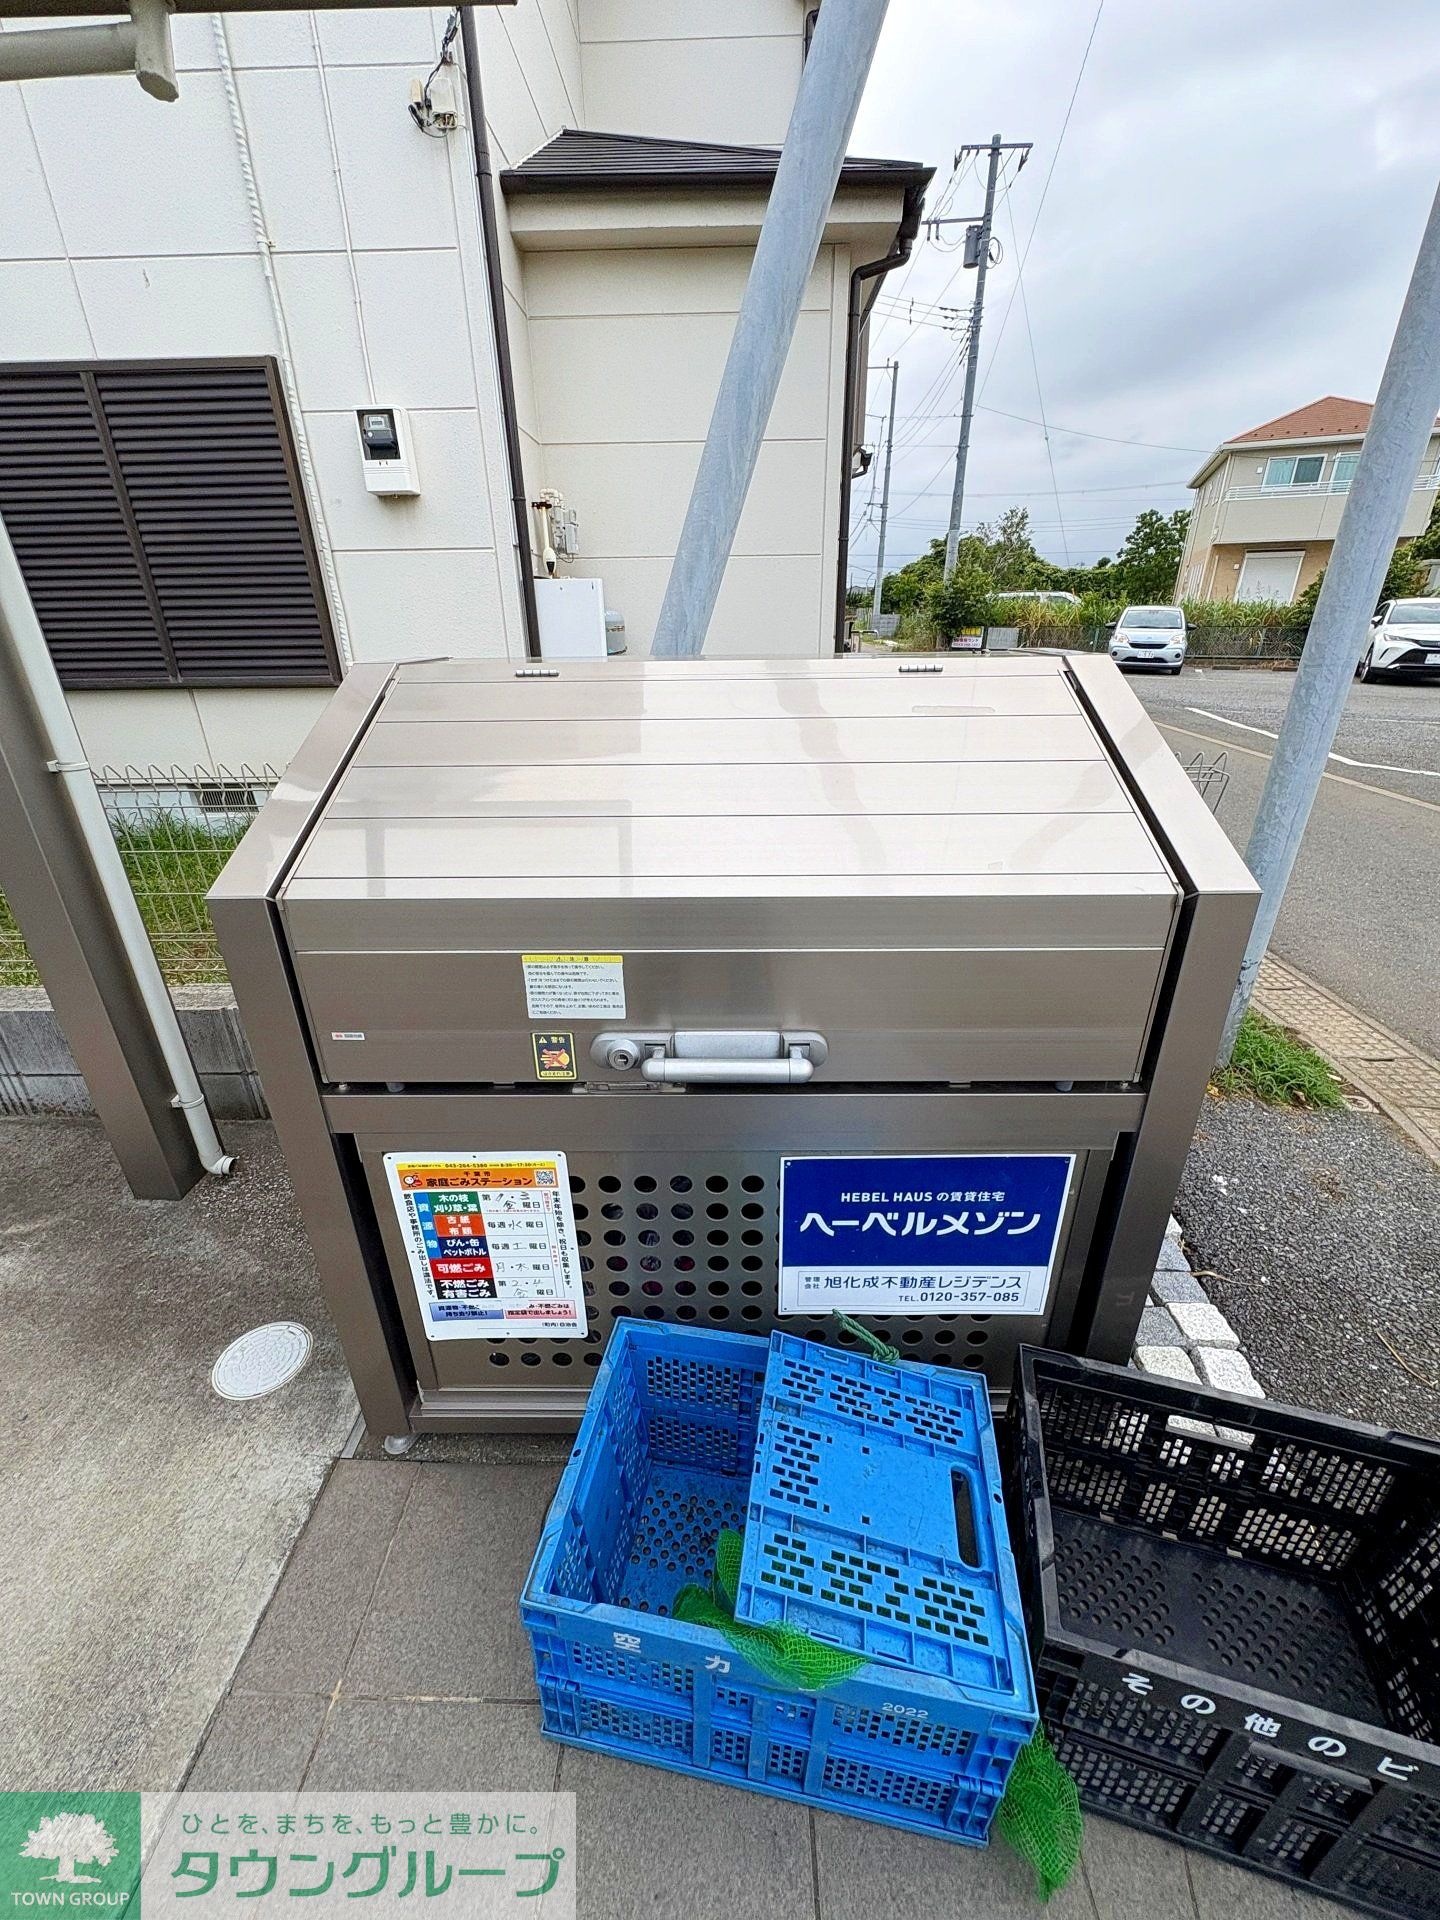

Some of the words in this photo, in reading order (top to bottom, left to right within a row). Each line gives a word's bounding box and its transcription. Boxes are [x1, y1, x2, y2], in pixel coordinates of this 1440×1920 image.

[425, 1177, 533, 1187] 家庭ごみステーション
[438, 1194, 469, 1203] 木の枝
[841, 1192, 890, 1203] HEBEL
[893, 1191, 933, 1202] HAUS
[936, 1191, 1006, 1202] の賃貸住宅
[799, 1211, 1042, 1237] ヘーベルメゾン
[446, 1238, 479, 1247] びん・缶
[443, 1248, 487, 1256] ペットボトル
[436, 1263, 486, 1273] 可燃ごみ
[440, 1279, 490, 1288] 不燃ごみ
[824, 1275, 1023, 1290] 旭化成不動産レジデンス
[442, 1288, 491, 1298] 有害ごみ
[881, 1700, 930, 1719] 2022
